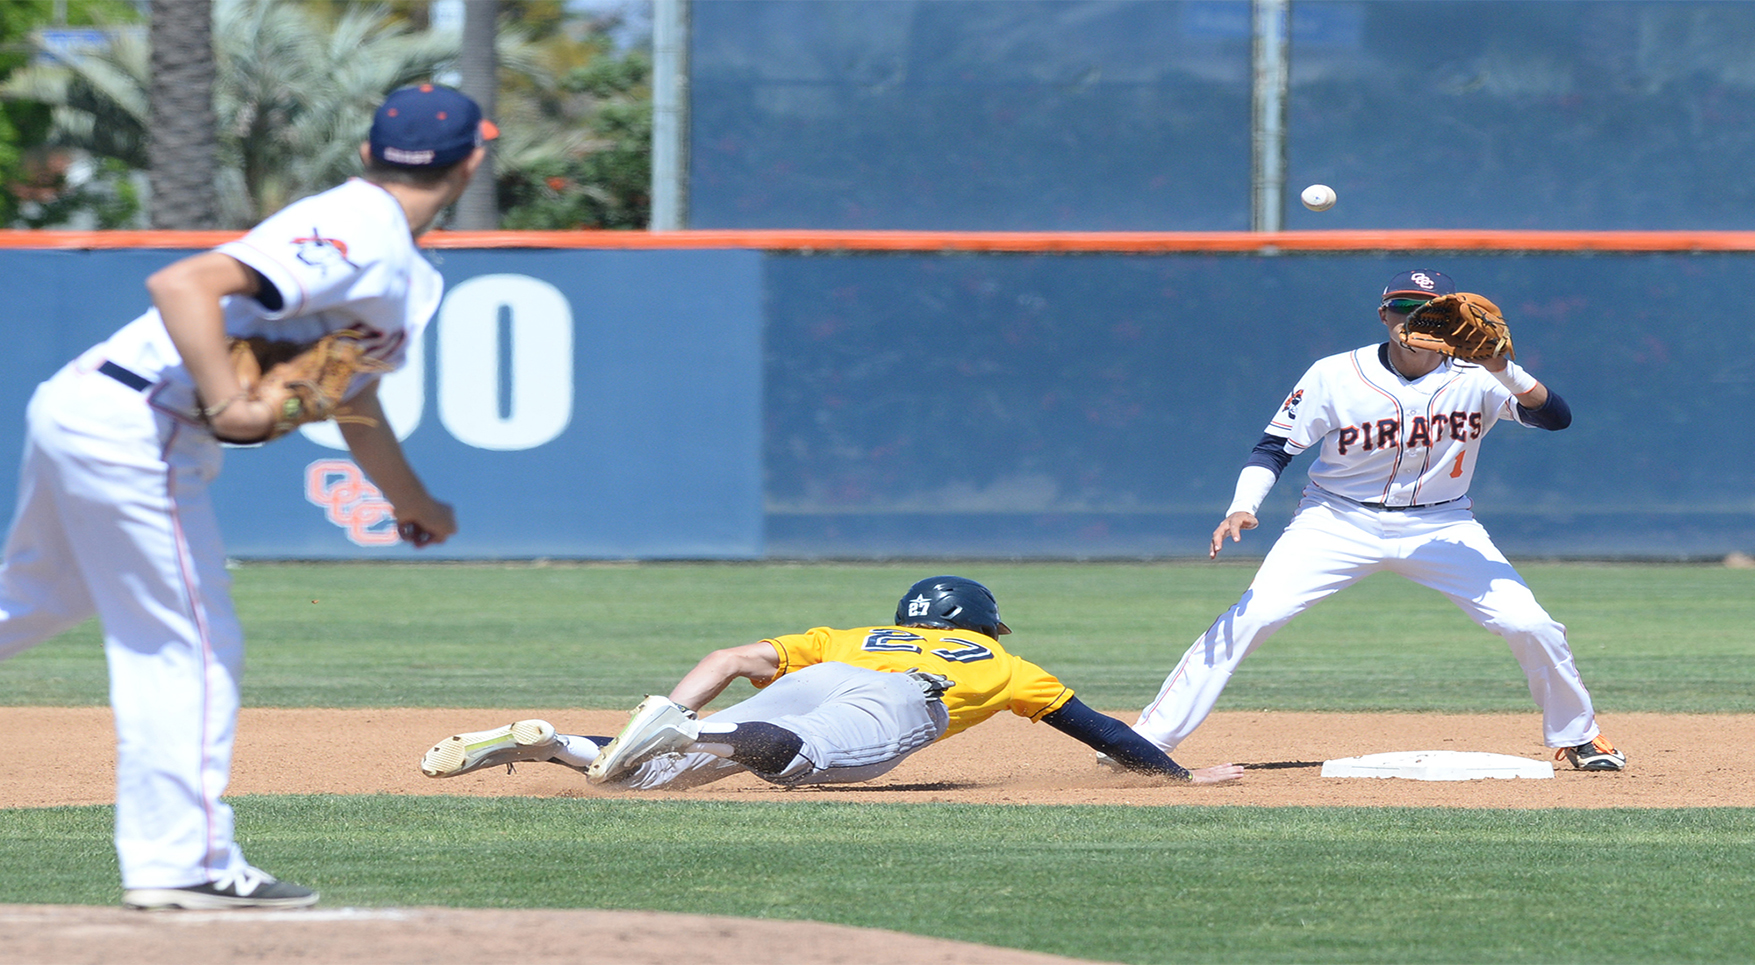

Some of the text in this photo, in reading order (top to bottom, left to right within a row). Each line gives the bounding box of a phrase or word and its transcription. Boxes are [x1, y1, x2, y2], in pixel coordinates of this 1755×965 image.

[1338, 411, 1482, 455] PIRATES
[1449, 450, 1466, 478] 1
[908, 601, 930, 616] 27
[861, 628, 994, 663] 27
